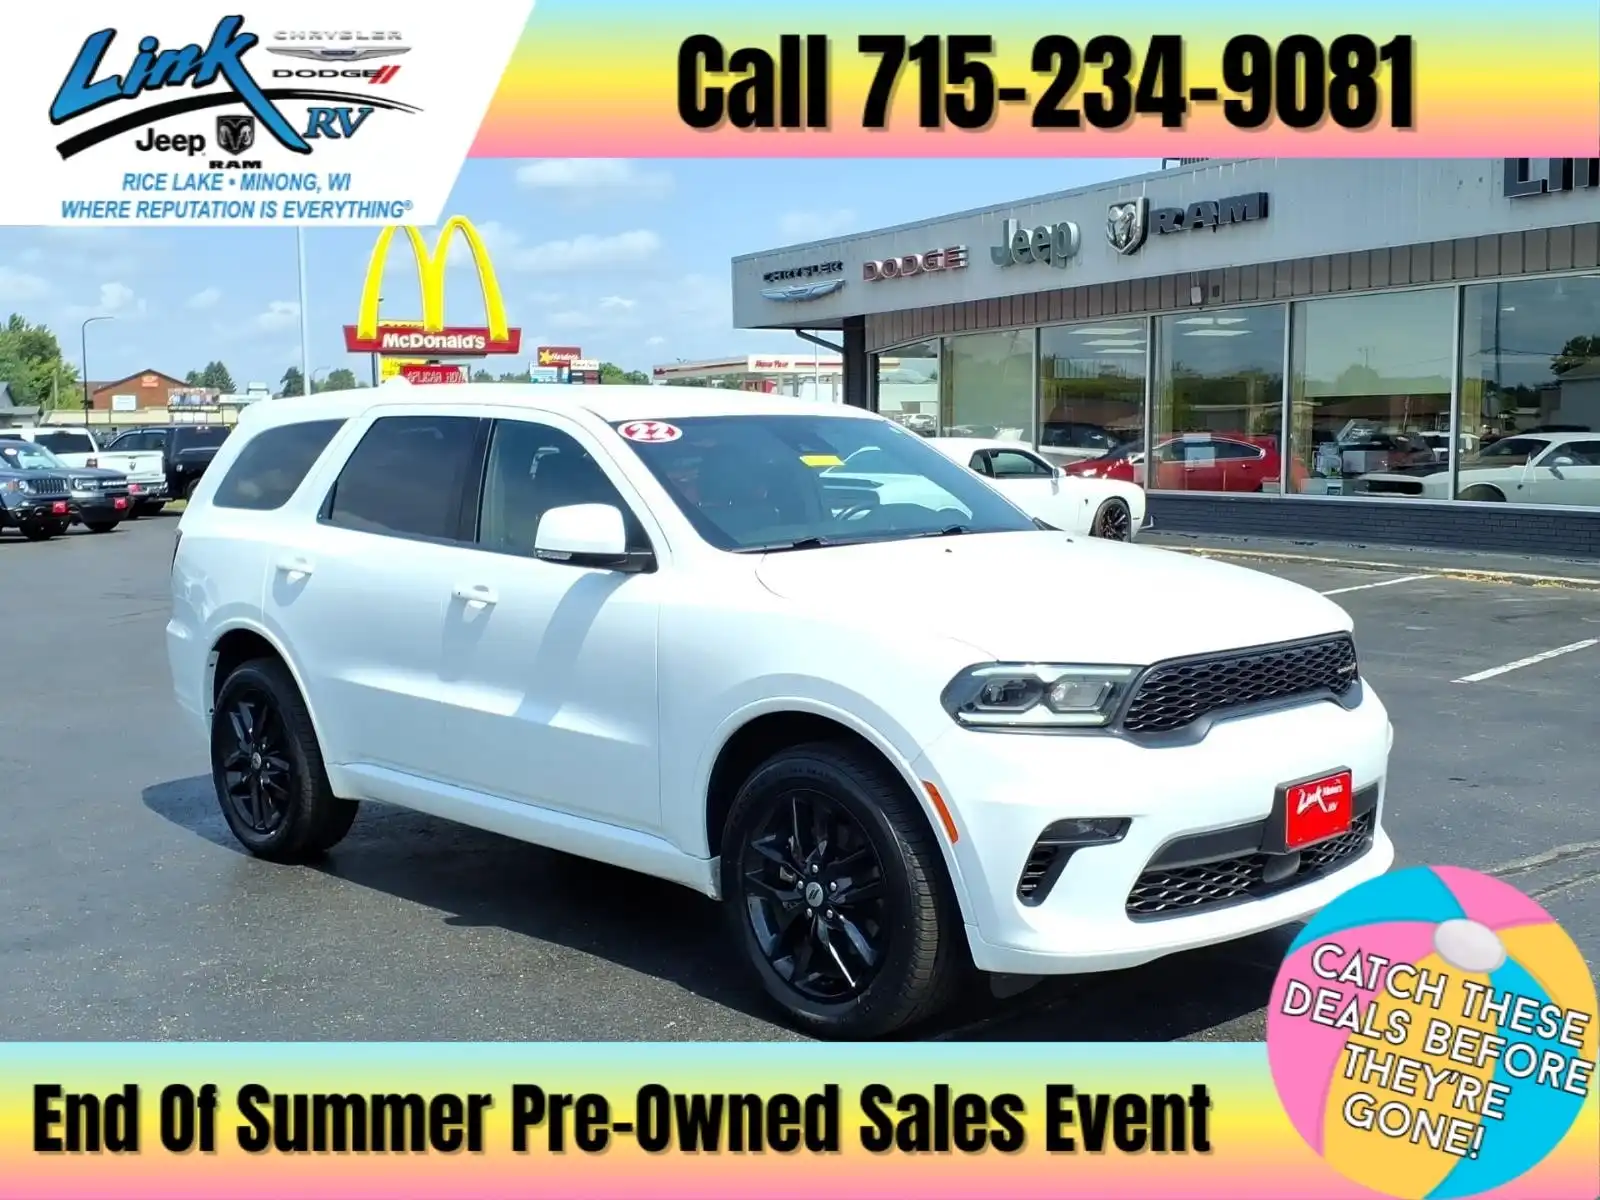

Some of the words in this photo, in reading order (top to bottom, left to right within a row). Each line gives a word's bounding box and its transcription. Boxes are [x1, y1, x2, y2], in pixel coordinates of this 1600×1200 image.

[1149, 191, 1269, 235] RAM
[989, 218, 1081, 269] Jeep
[763, 260, 844, 283] CHRYSLER
[862, 244, 968, 281] DODGE
[381, 332, 486, 350] McDonald's
